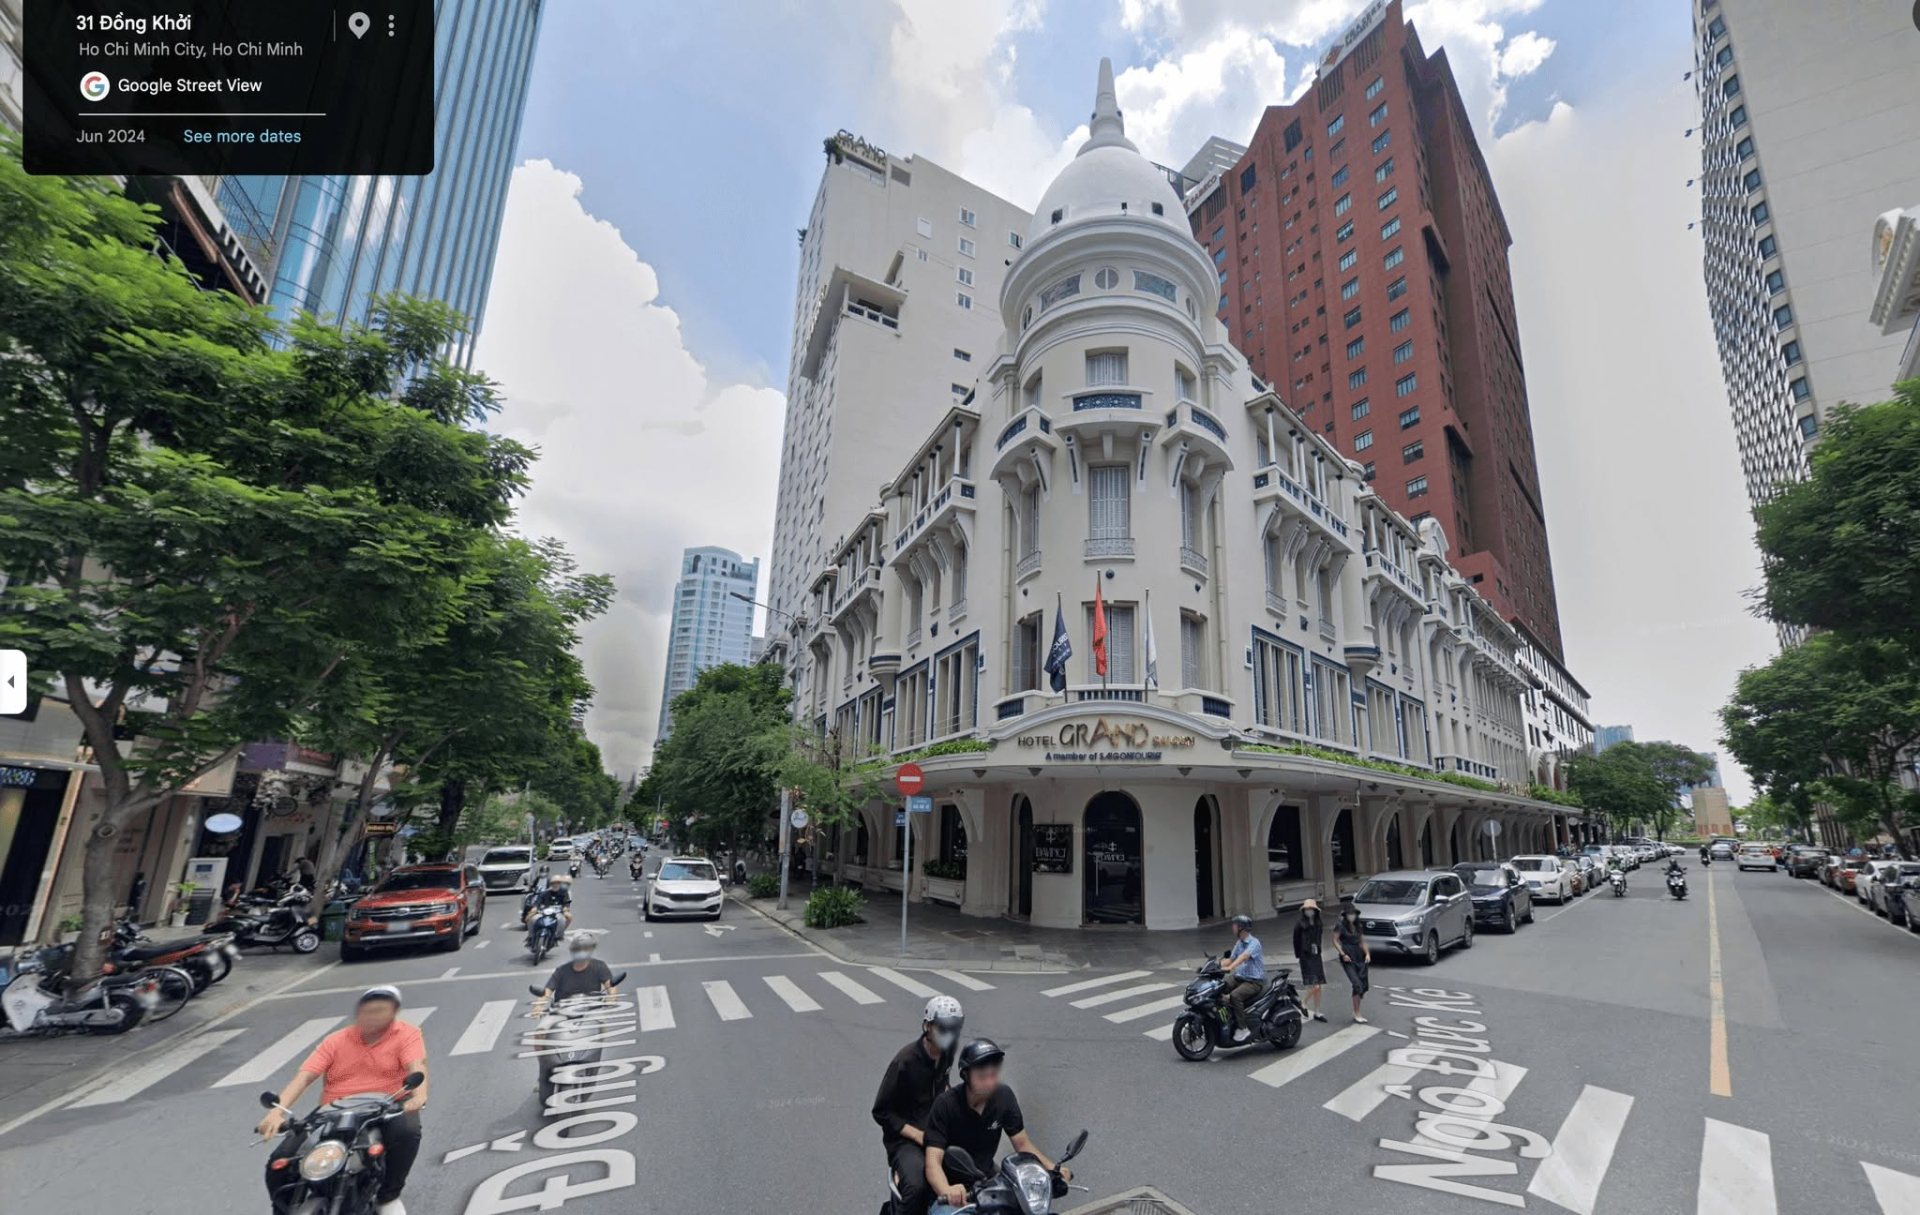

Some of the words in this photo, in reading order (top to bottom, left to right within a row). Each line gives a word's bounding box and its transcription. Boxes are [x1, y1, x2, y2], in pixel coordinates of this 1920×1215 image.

[1018, 735, 1056, 747] HOTEL
[1059, 716, 1149, 748] GRAND
[1045, 752, 1052, 761] A
[1053, 752, 1087, 761] member
[1089, 752, 1098, 761] of
[1099, 751, 1163, 761] SAIGONTOURIST
